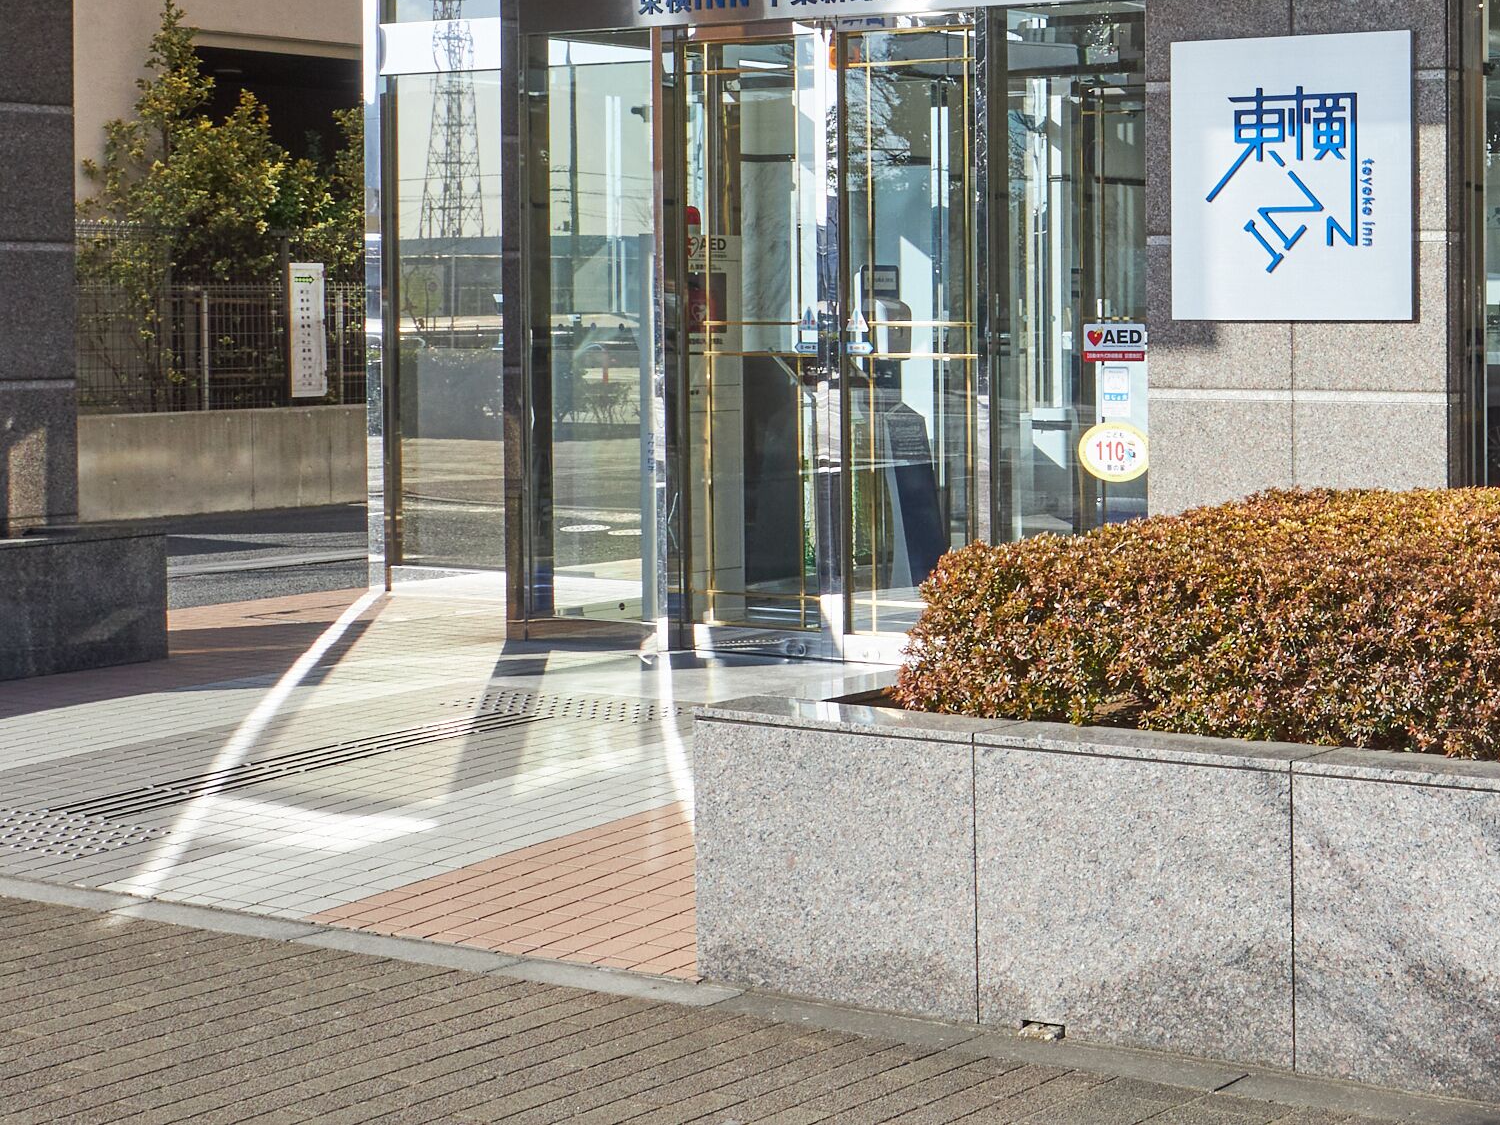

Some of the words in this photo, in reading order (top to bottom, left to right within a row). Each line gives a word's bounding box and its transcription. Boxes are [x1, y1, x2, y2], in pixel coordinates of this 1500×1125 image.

[1361, 158, 1376, 216] toyoko
[1361, 221, 1374, 247] inn
[699, 238, 727, 251] AED
[1103, 329, 1142, 344] AED
